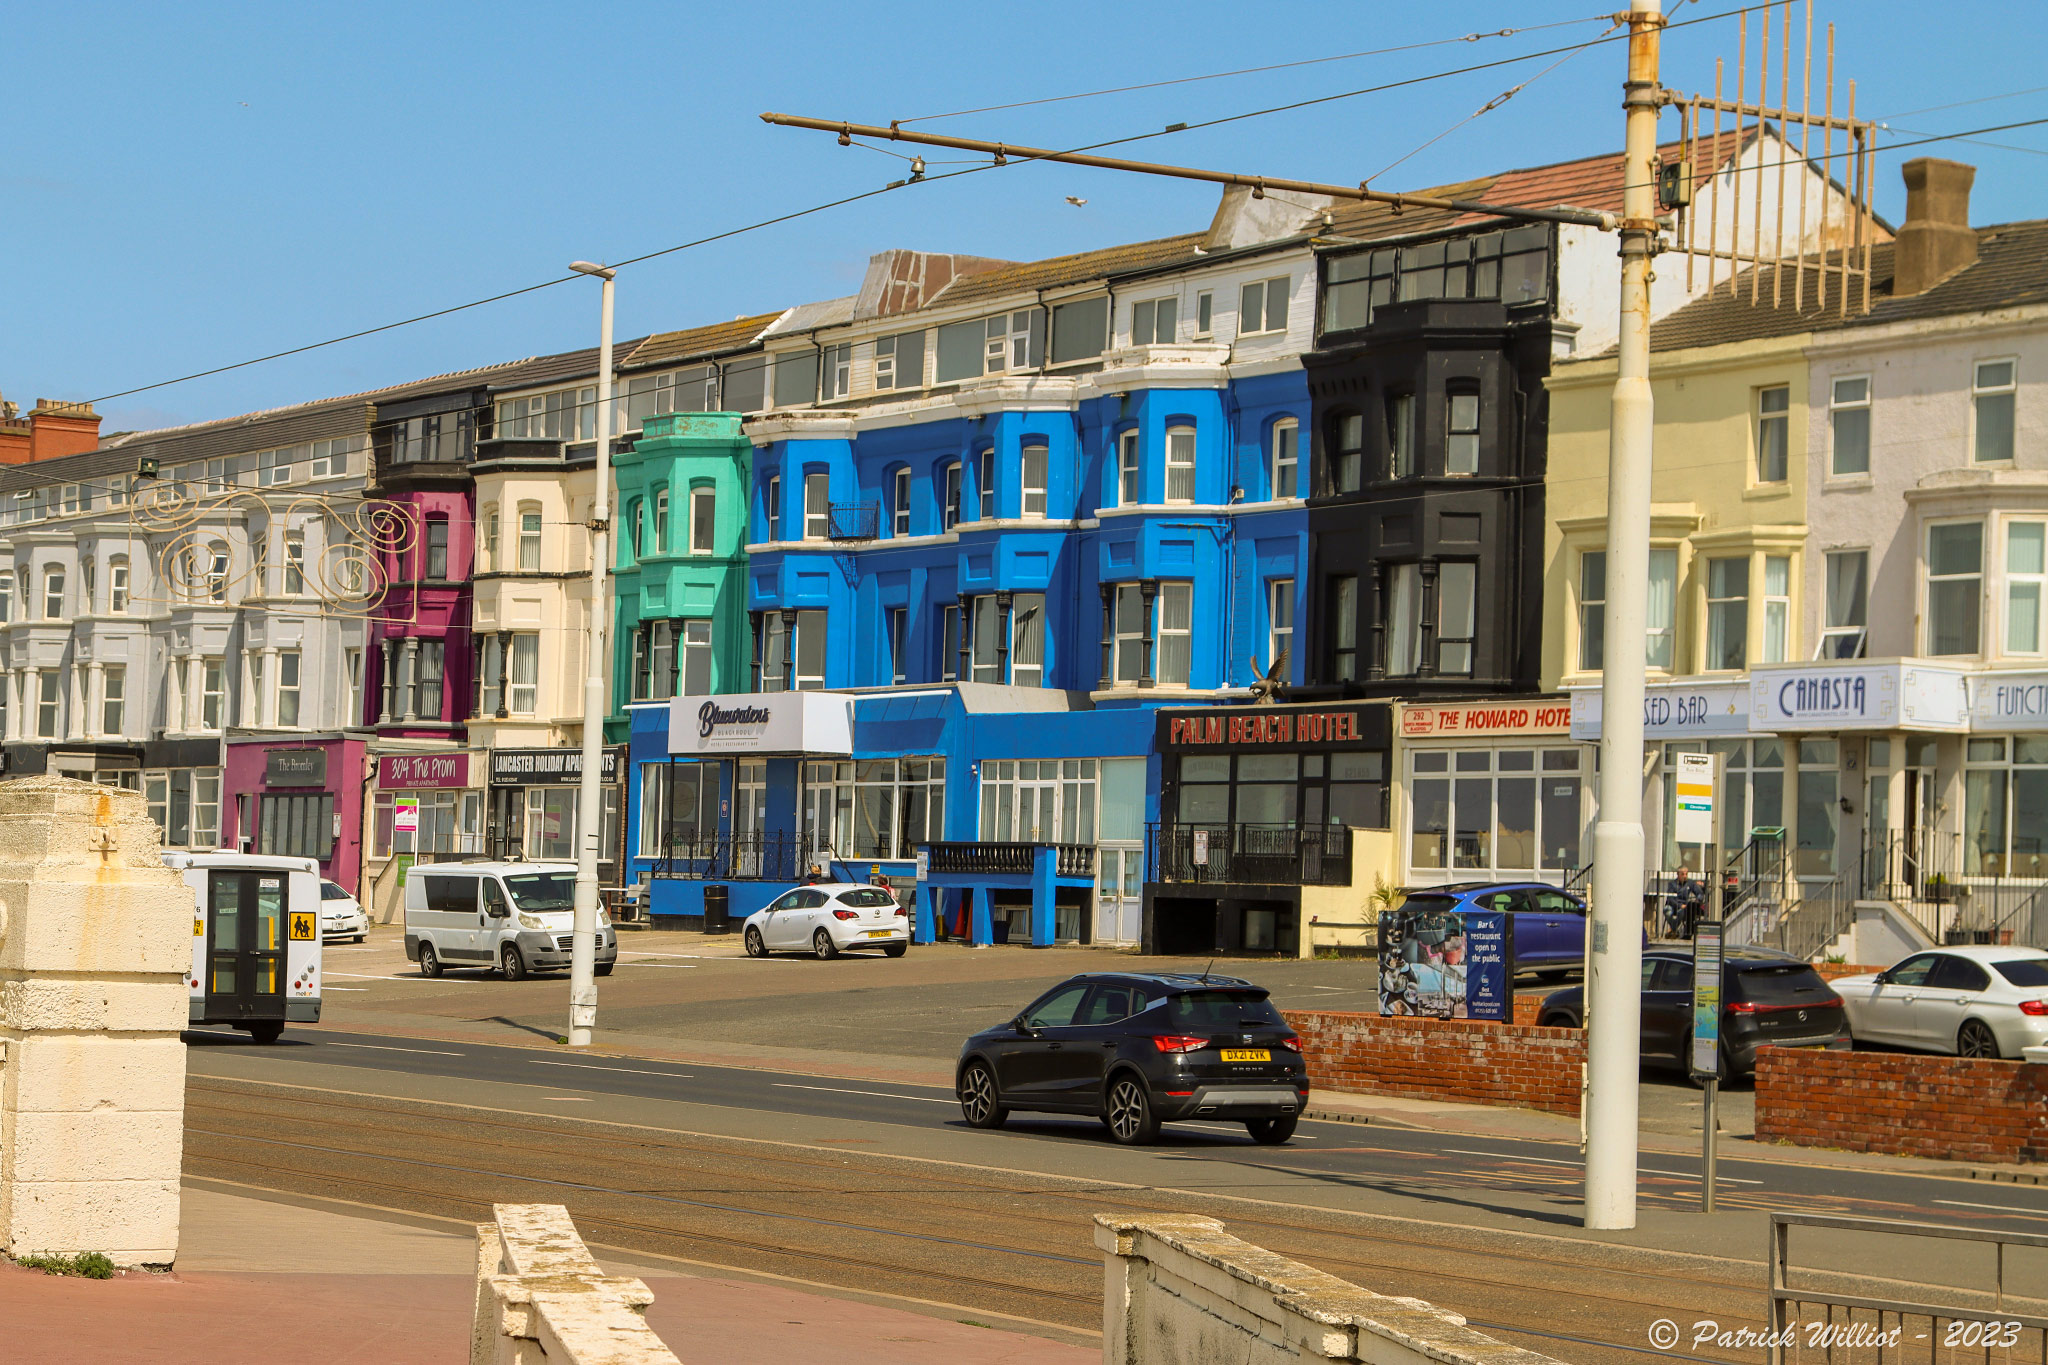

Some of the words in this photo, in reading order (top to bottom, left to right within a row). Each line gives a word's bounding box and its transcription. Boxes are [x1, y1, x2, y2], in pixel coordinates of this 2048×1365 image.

[1778, 676, 1866, 717] CANASTA
[698, 700, 770, 738] Bluewaters
[1413, 711, 1425, 721] 292
[1439, 711, 1460, 730] THE
[1465, 709, 1529, 729] HOWARD
[1534, 707, 1571, 727] HOTE
[1643, 697, 1670, 726] SED
[1677, 696, 1708, 725] BAR
[1170, 717, 1224, 745] PALM
[1228, 714, 1292, 744] BEACH
[1297, 711, 1363, 743] HOTEL
[278, 758, 290, 772] The
[391, 758, 409, 779] 304
[412, 757, 429, 779] The
[495, 755, 534, 773] LANCASTER
[534, 754, 565, 773] HOLIDAY
[1477, 921, 1488, 929] Bar
[1488, 921, 1495, 929] &
[1474, 945, 1490, 953] open
[1471, 954, 1481, 962] the
[1482, 955, 1501, 964] public
[1249, 1050, 1266, 1060] ZVK
